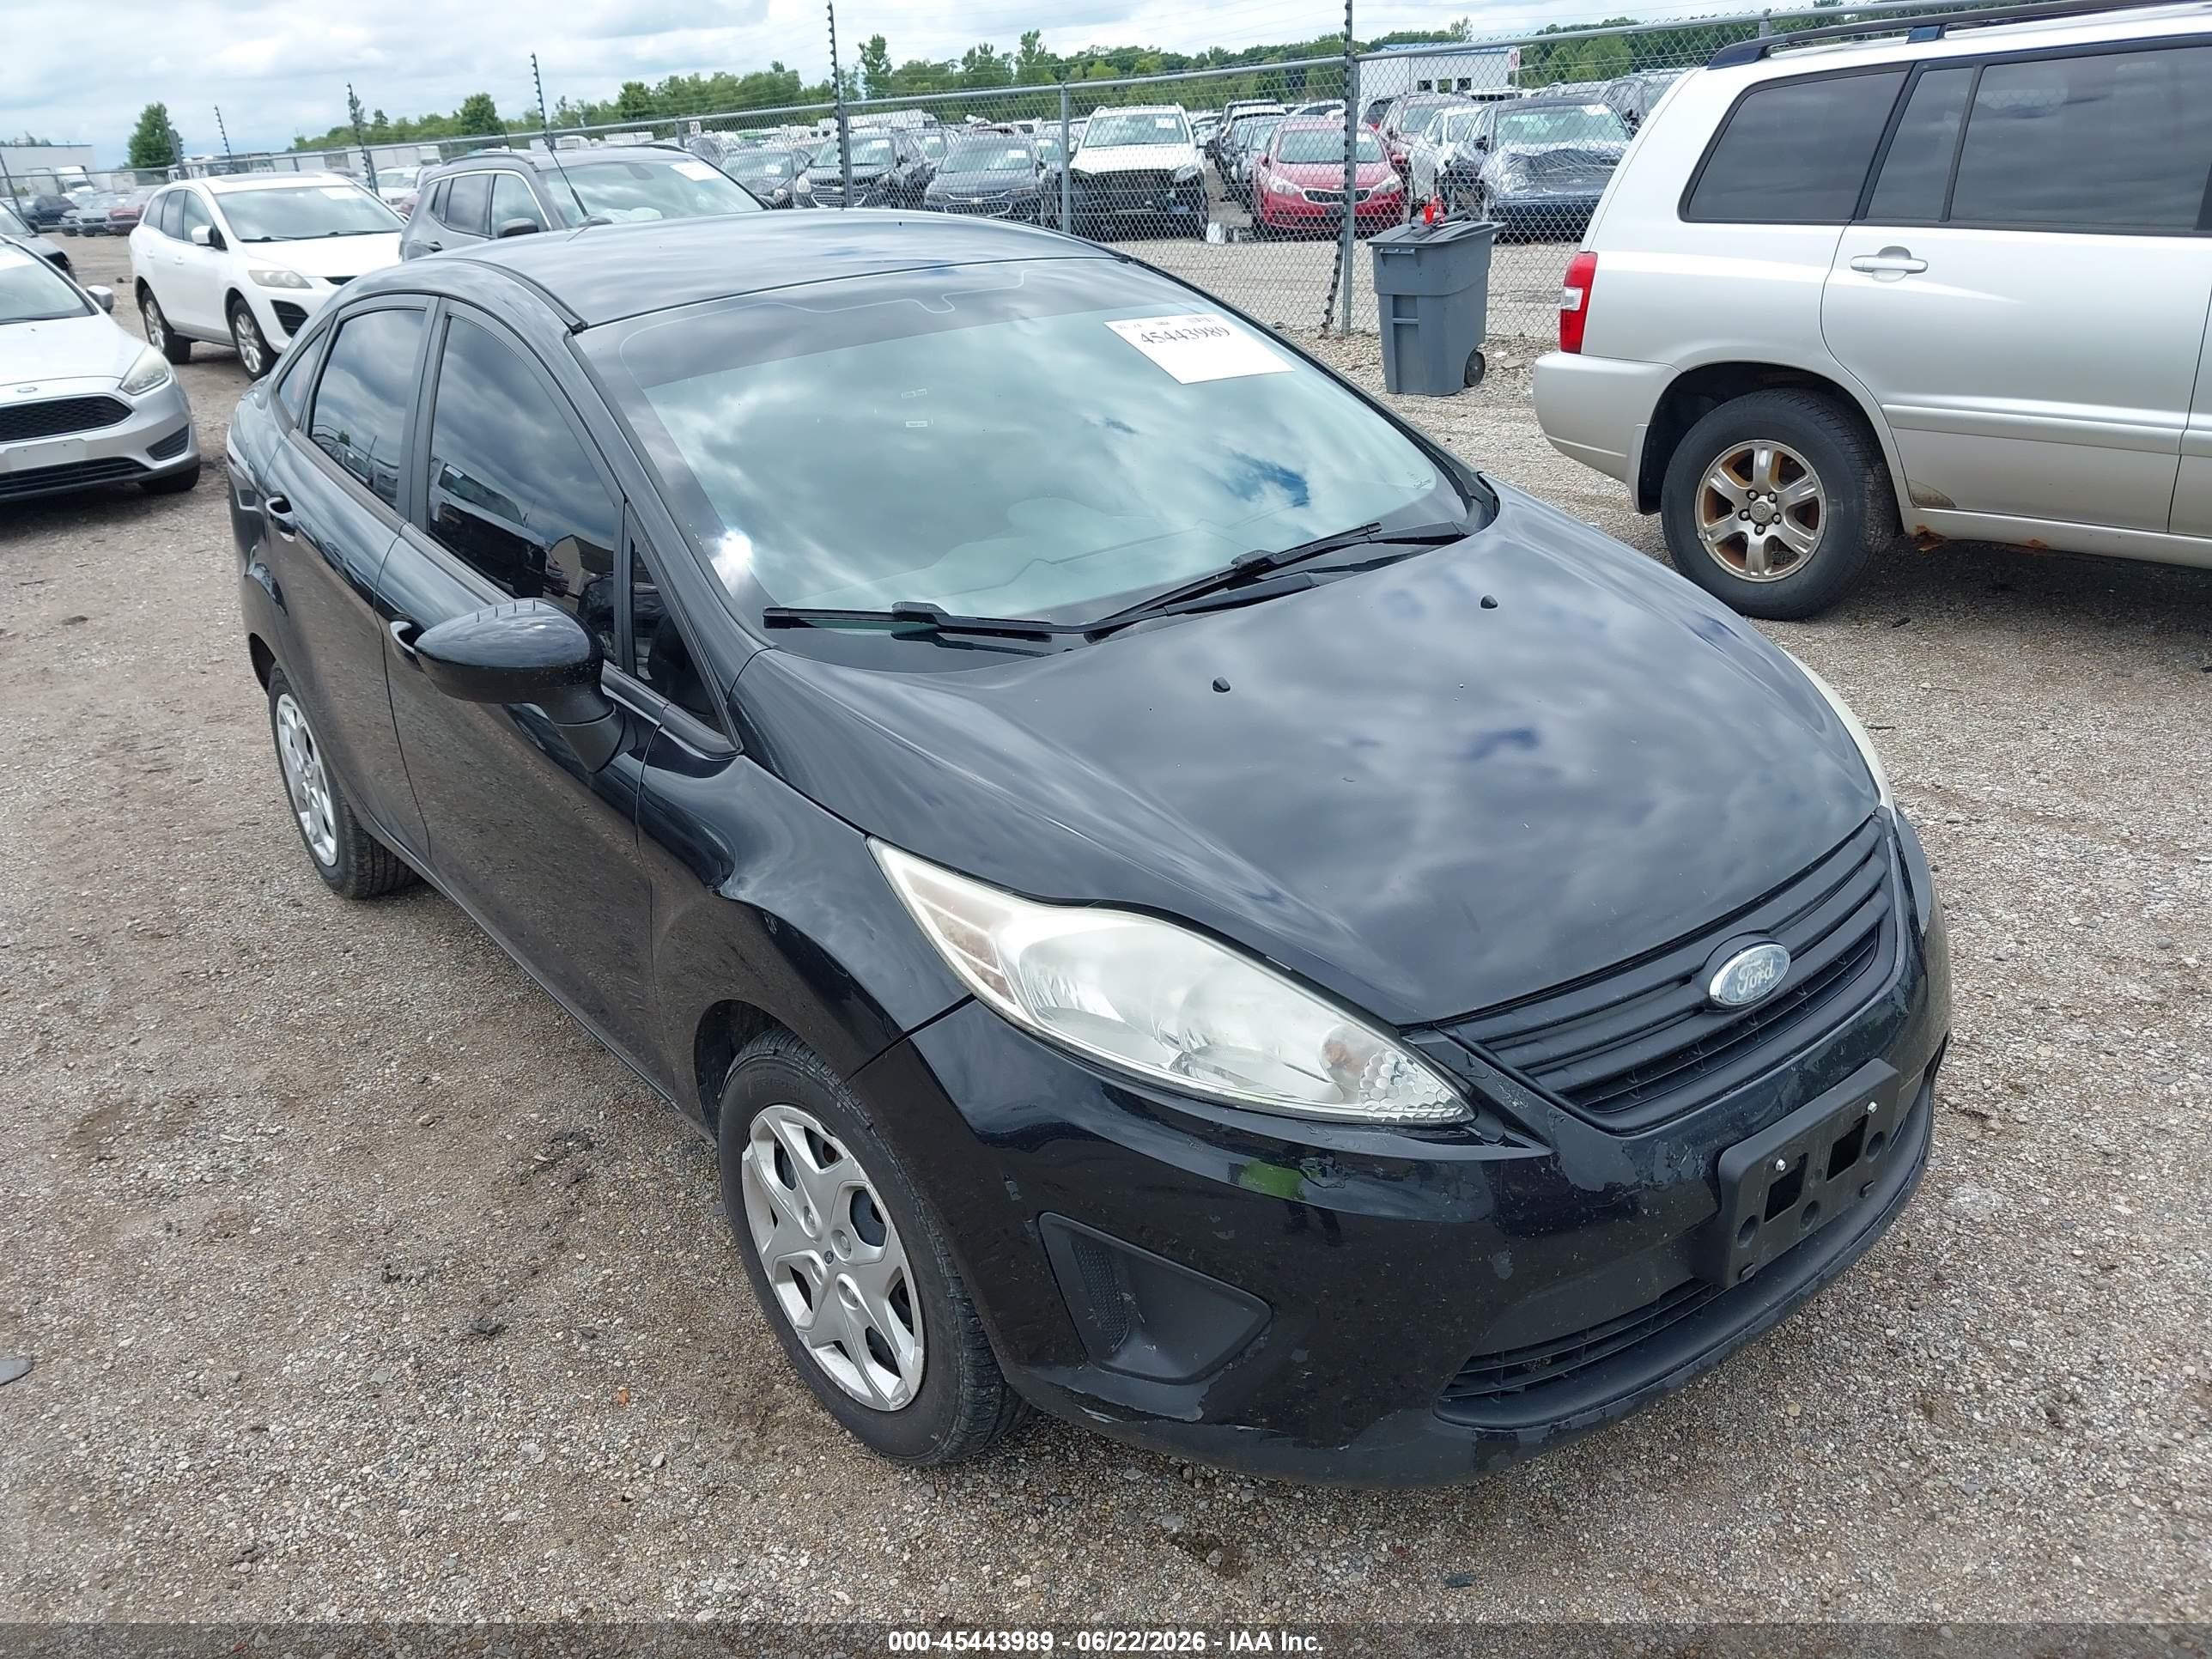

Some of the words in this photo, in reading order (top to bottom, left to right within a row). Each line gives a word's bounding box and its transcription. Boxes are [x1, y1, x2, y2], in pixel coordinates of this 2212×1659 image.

[1510, 52, 1518, 66] 10
[1140, 325, 1231, 344] 45443989
[1736, 957, 1776, 995] Ford
